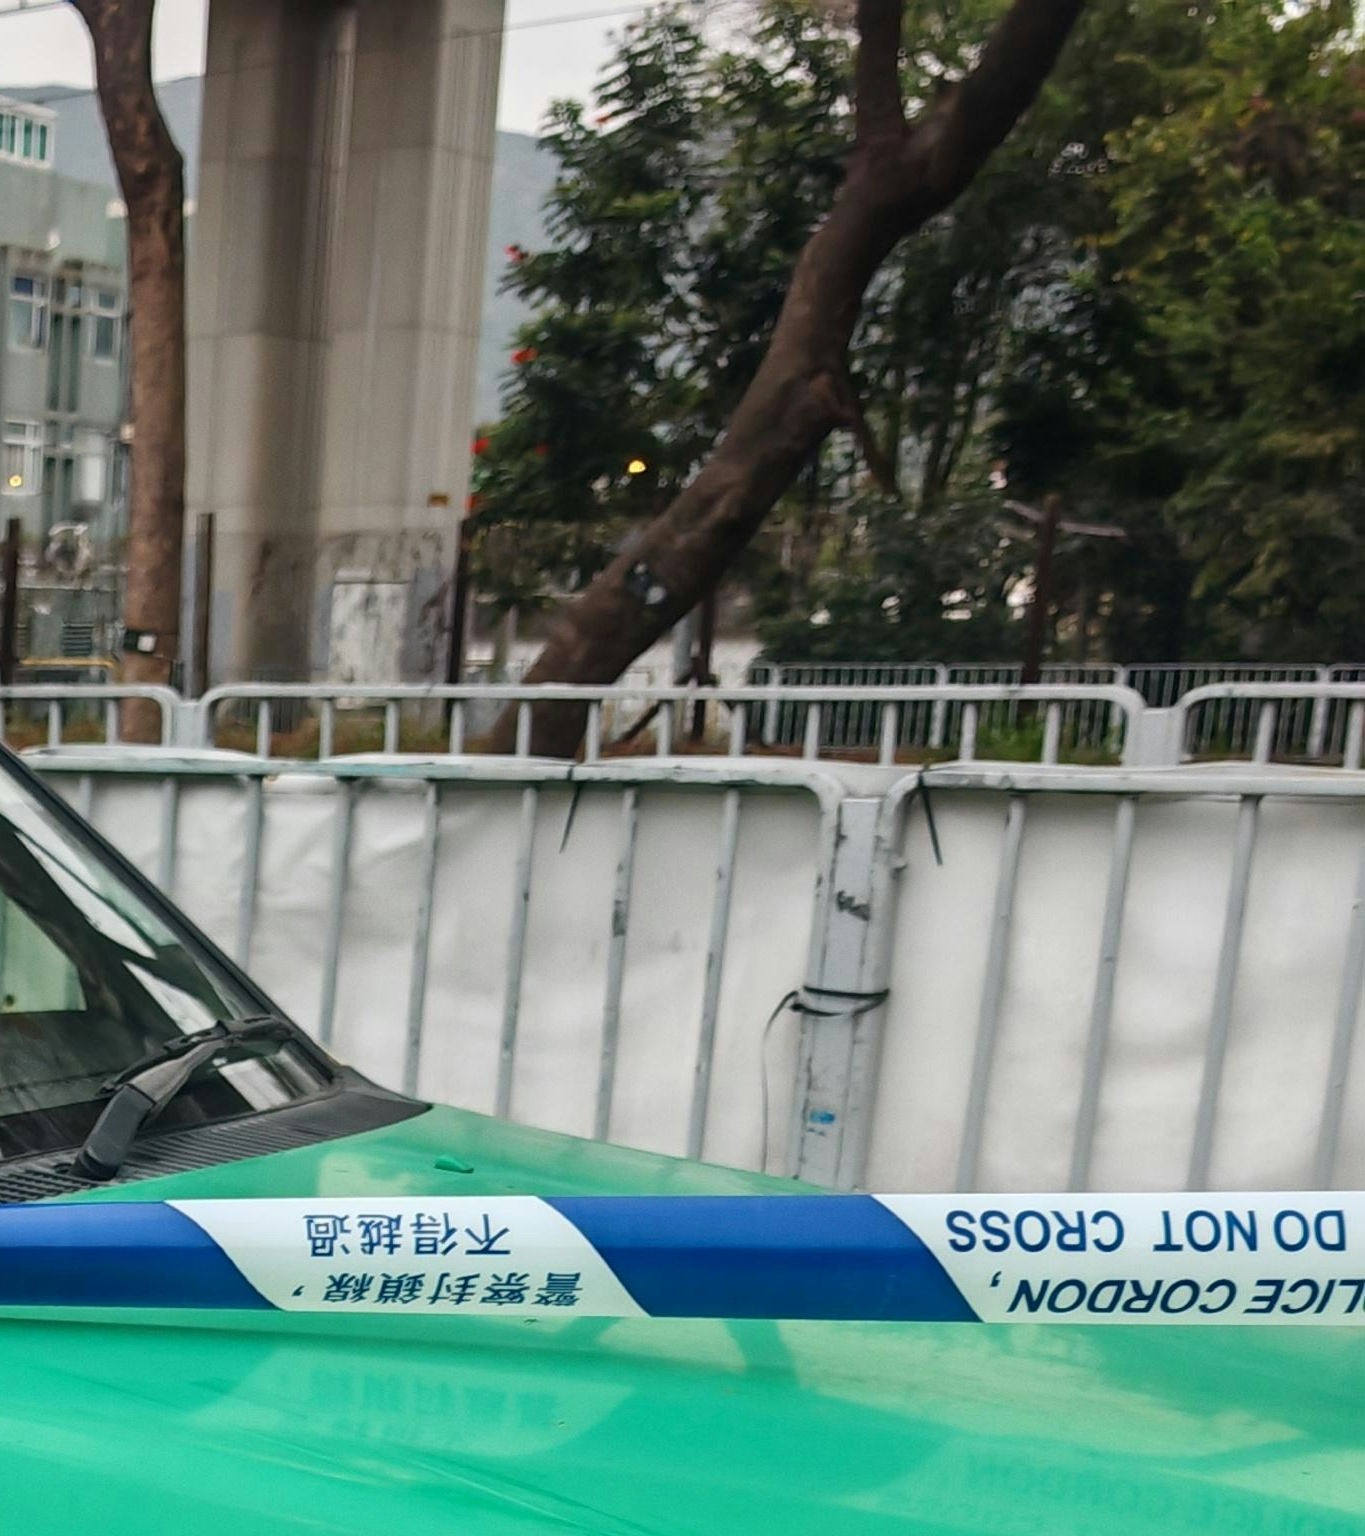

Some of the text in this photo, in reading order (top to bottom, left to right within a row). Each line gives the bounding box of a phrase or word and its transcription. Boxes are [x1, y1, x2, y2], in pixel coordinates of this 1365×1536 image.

[303, 1212, 511, 1257] 不得越過
[945, 1209, 1347, 1253] DO NOT CROSS
[989, 1270, 1365, 1314] LICE CORDON,
